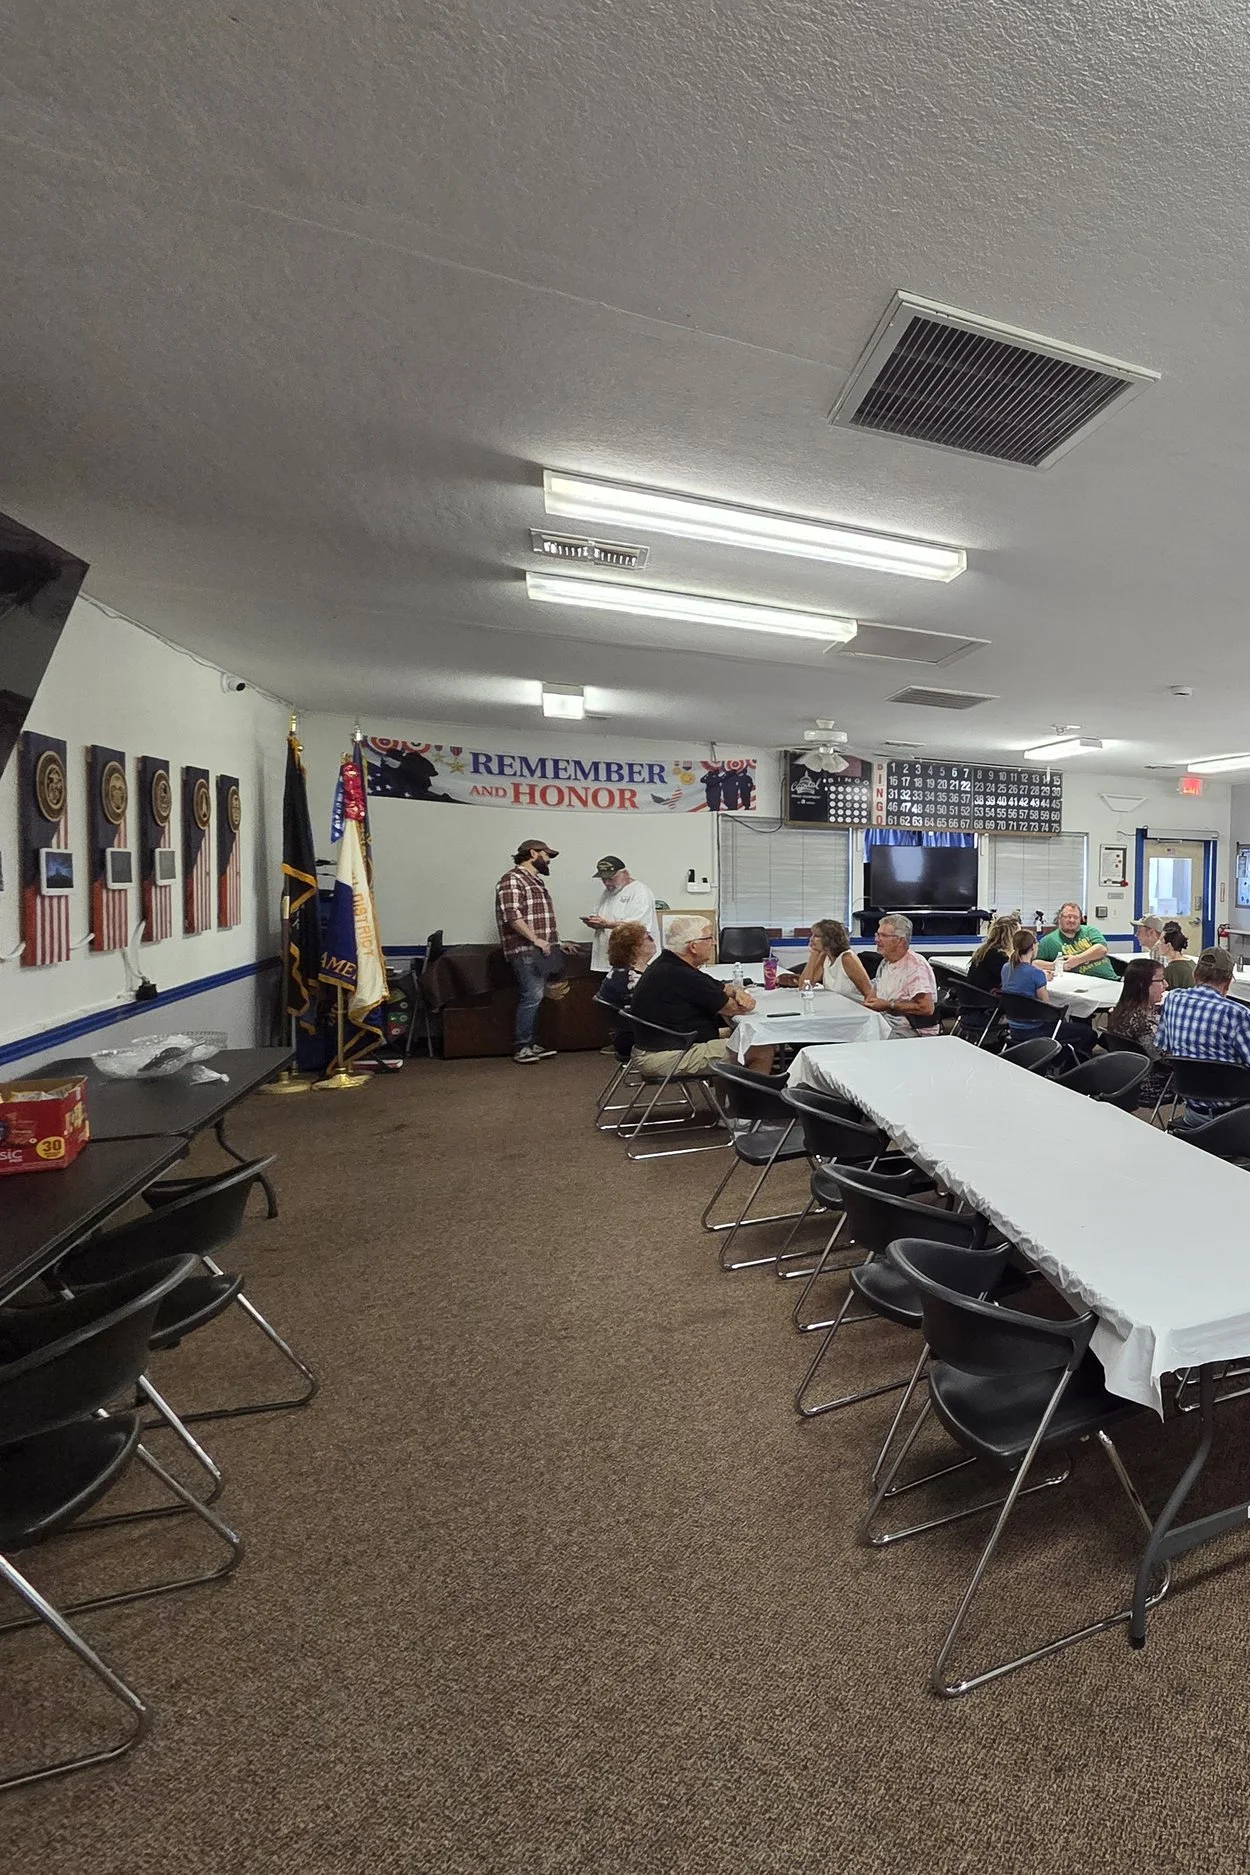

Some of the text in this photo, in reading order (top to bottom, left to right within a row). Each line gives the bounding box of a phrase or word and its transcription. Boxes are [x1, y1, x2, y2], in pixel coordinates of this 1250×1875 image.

[469, 751, 668, 785] REMEMBER
[892, 762, 896, 772] 1
[903, 764, 909, 773] 2
[916, 764, 921, 774] 3
[928, 766, 933, 775] 4
[940, 767, 945, 776] 5
[952, 768, 957, 777] 6
[964, 768, 969, 778] 7
[977, 770, 982, 779] 8
[988, 771, 994, 780] 9
[999, 772, 1007, 781] 10
[1011, 773, 1017, 781] 11
[1021, 773, 1028, 782] 12
[1032, 774, 1040, 783] 13
[1053, 776, 1061, 785] 15
[889, 776, 1061, 796] 16 17 18 19 20 21 22 23 24 25 26 27 28 29 30
[469, 782, 640, 811] AND HONOR
[888, 789, 1061, 809] 31 32 33 34 35 36 37 38 39 40 41 42 43 44 45
[888, 802, 1062, 820] 46 47 48 49 50 51 52 53 54 55 56 57 58 59 60
[888, 815, 1060, 832] 61 62 63 64 65 66 67 68 69 70 71 72 73 74 75
[320, 951, 356, 980] AME
[41, 1139, 62, 1152] 30
